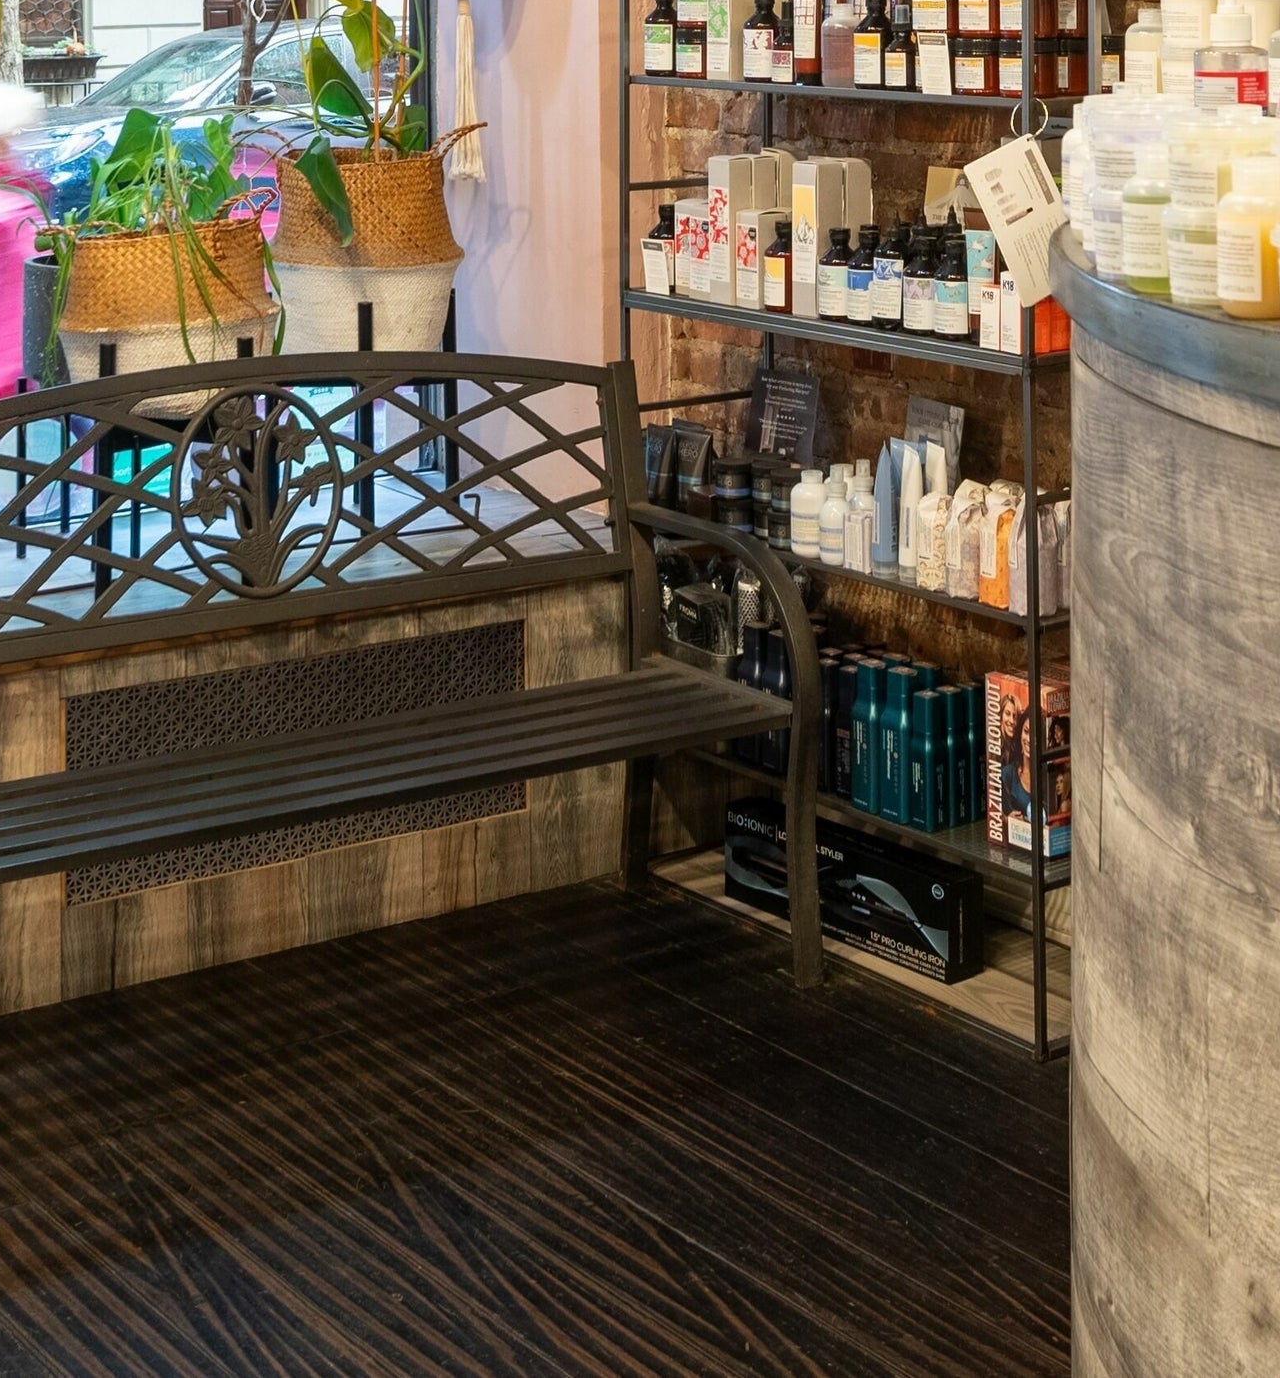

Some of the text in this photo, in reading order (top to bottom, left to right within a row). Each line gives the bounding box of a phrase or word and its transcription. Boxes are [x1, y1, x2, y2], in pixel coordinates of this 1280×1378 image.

[1002, 280, 1014, 292] K18
[982, 290, 994, 300] K18
[987, 681, 1003, 842] BRAZILIAN BLOWOUT
[820, 846, 844, 862] STYLER
[881, 934, 896, 948] PRO
[896, 939, 927, 960] CURLING
[927, 951, 946, 968] IRON
